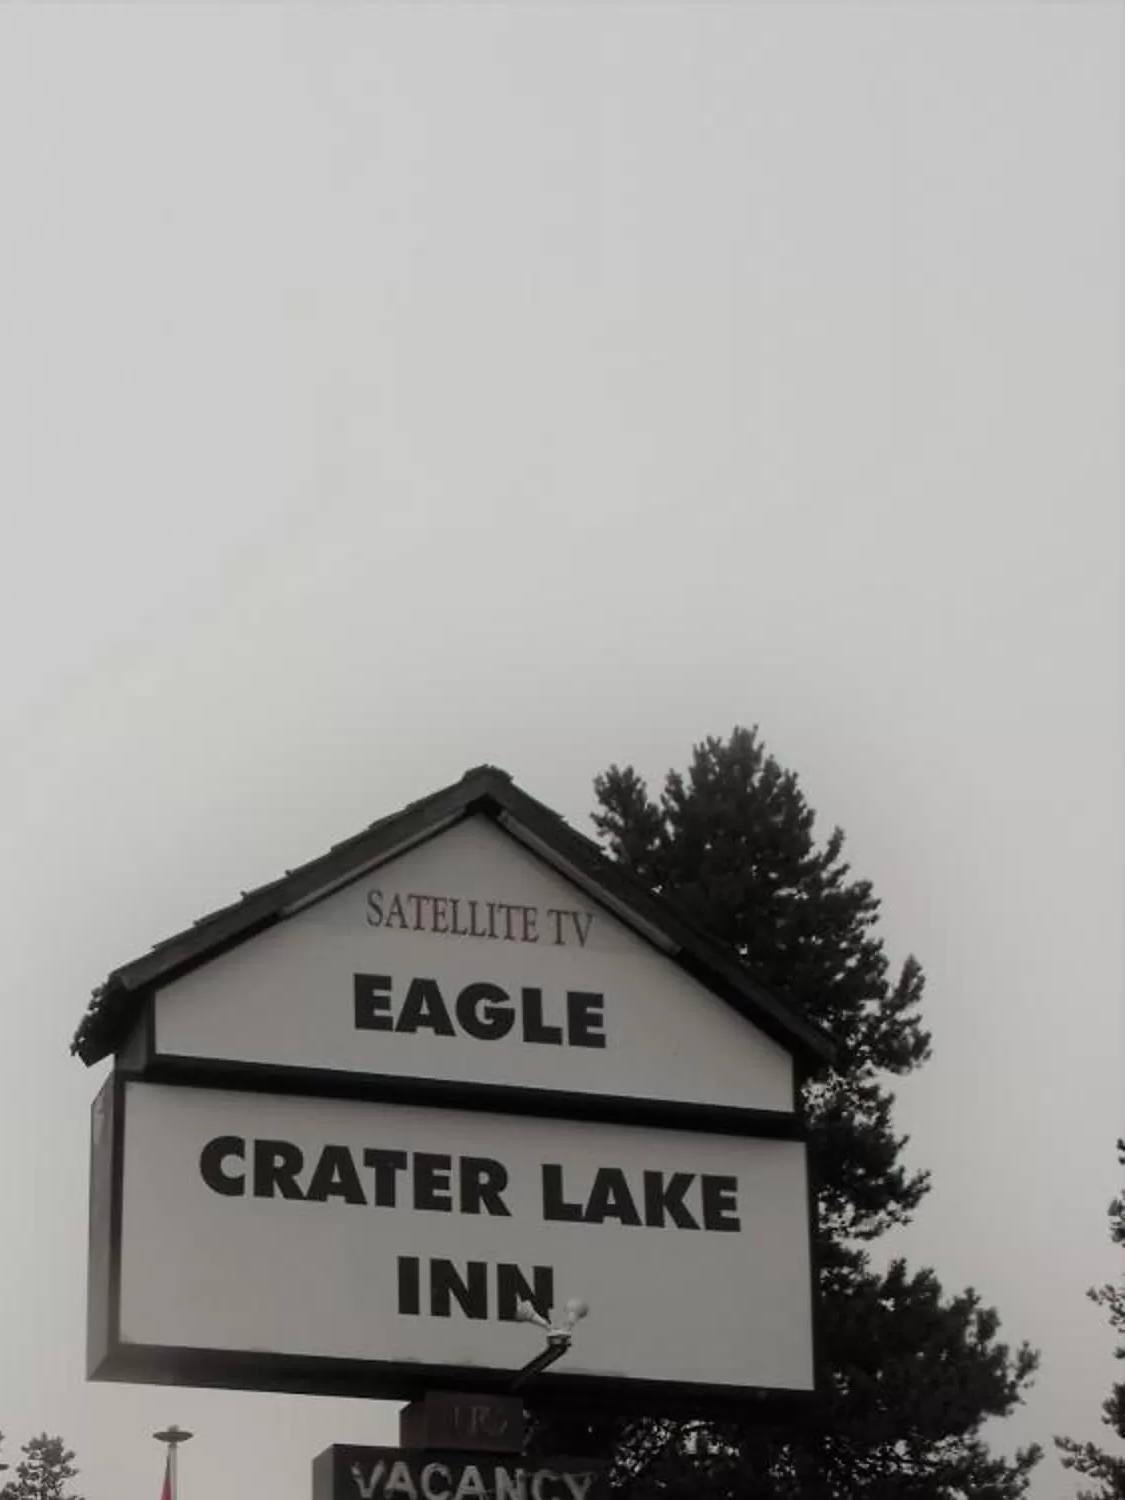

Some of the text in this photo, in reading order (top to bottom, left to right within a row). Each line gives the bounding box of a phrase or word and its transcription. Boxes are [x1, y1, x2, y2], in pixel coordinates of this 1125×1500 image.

[366, 888, 595, 948] SATELLITE TV
[353, 973, 607, 1049] EAGLE
[199, 1135, 742, 1233] CRATER LAKE
[397, 1256, 554, 1325] INN
